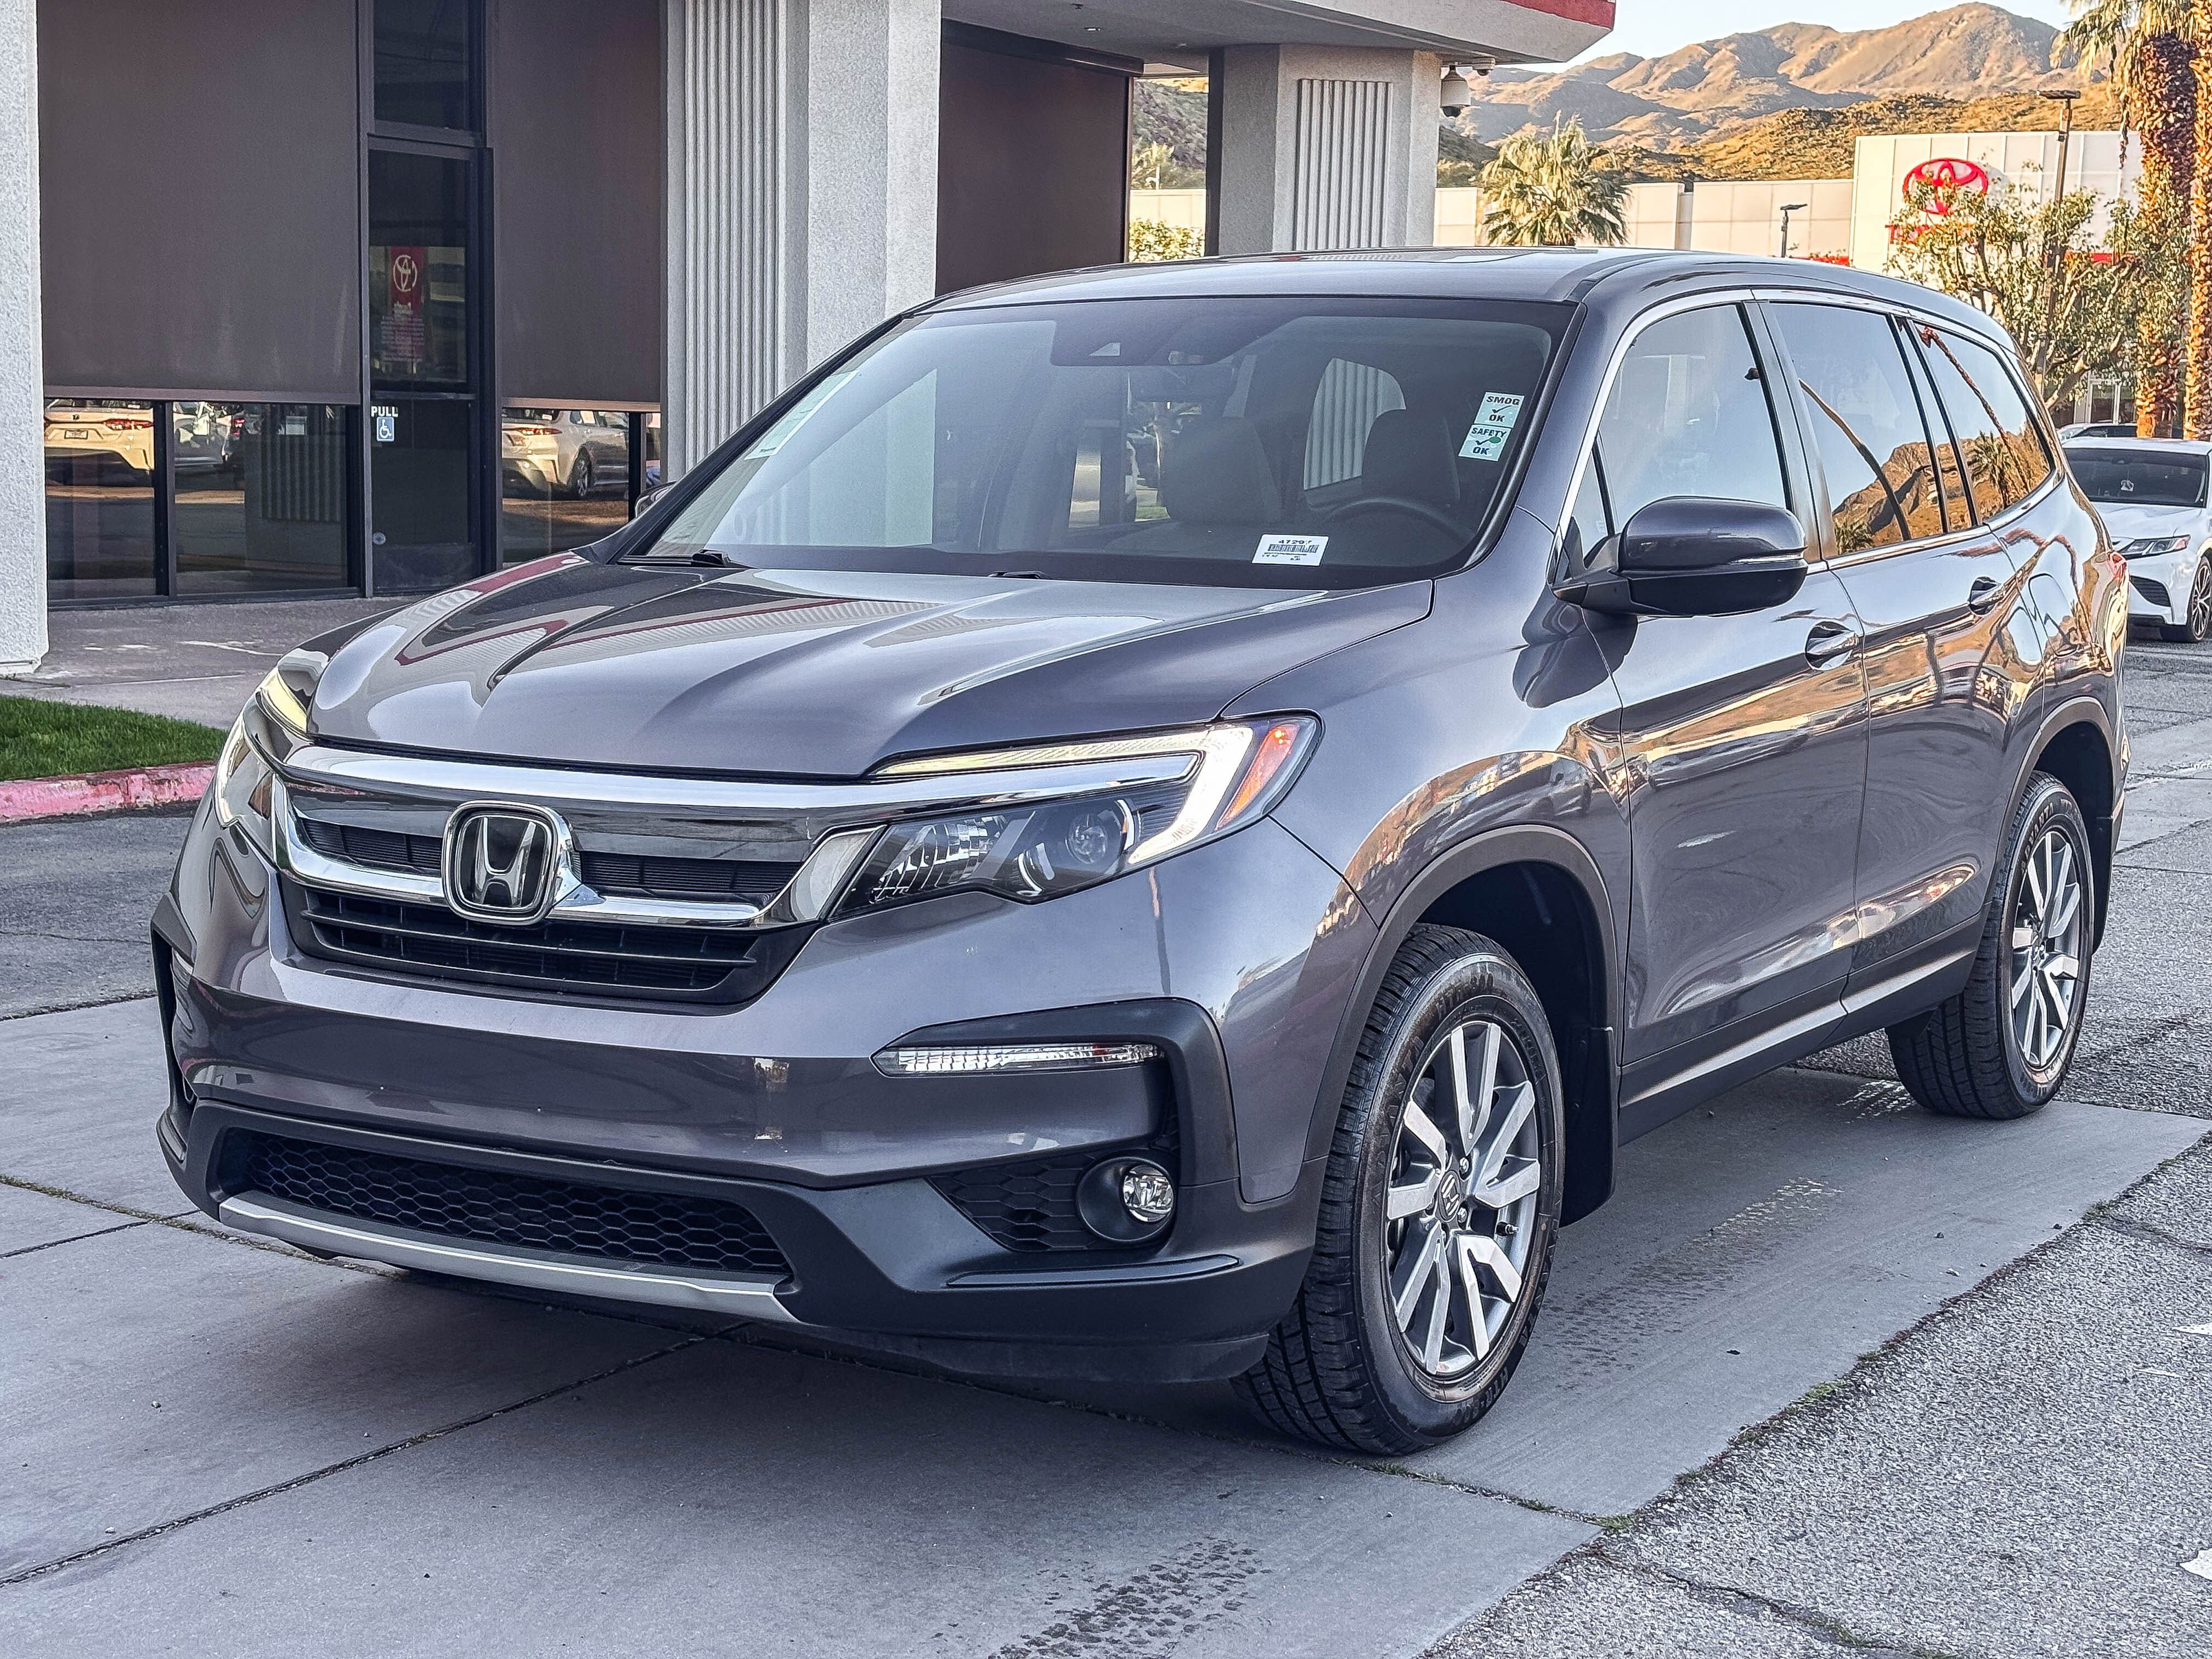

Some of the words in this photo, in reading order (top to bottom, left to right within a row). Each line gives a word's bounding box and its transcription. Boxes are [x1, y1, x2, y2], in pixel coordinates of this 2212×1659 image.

[1486, 396, 1520, 406] SMOG
[370, 405, 398, 417] PULL
[1488, 414, 1505, 422] OK
[1471, 427, 1507, 437] SAFETY
[1472, 447, 1489, 455] OK
